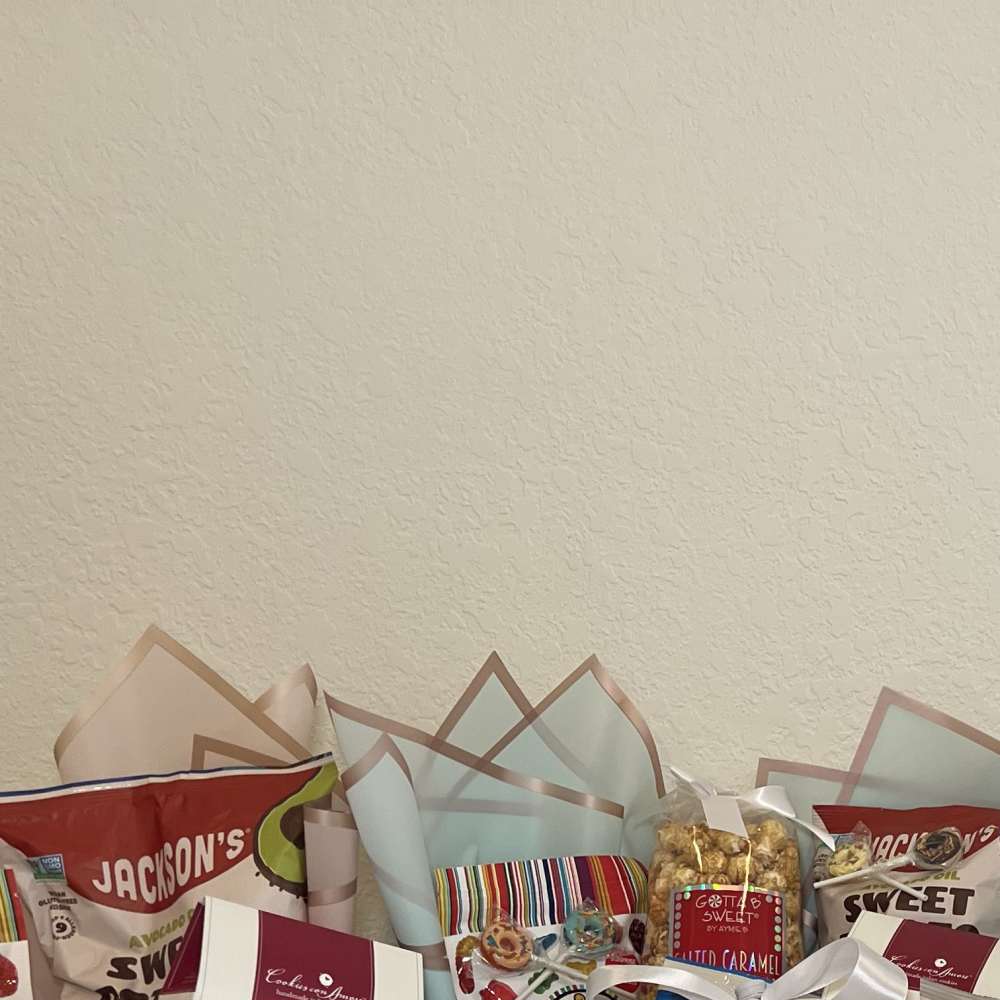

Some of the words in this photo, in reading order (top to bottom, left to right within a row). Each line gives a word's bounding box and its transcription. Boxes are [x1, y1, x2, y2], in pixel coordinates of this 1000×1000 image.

[92, 829, 245, 905] JACKSON'S
[702, 908, 755, 925] SWEET
[843, 886, 976, 924] SWEET
[129, 914, 187, 949] AVOCADO
[674, 950, 716, 967] LTED
[722, 949, 780, 976] CARAMEL
